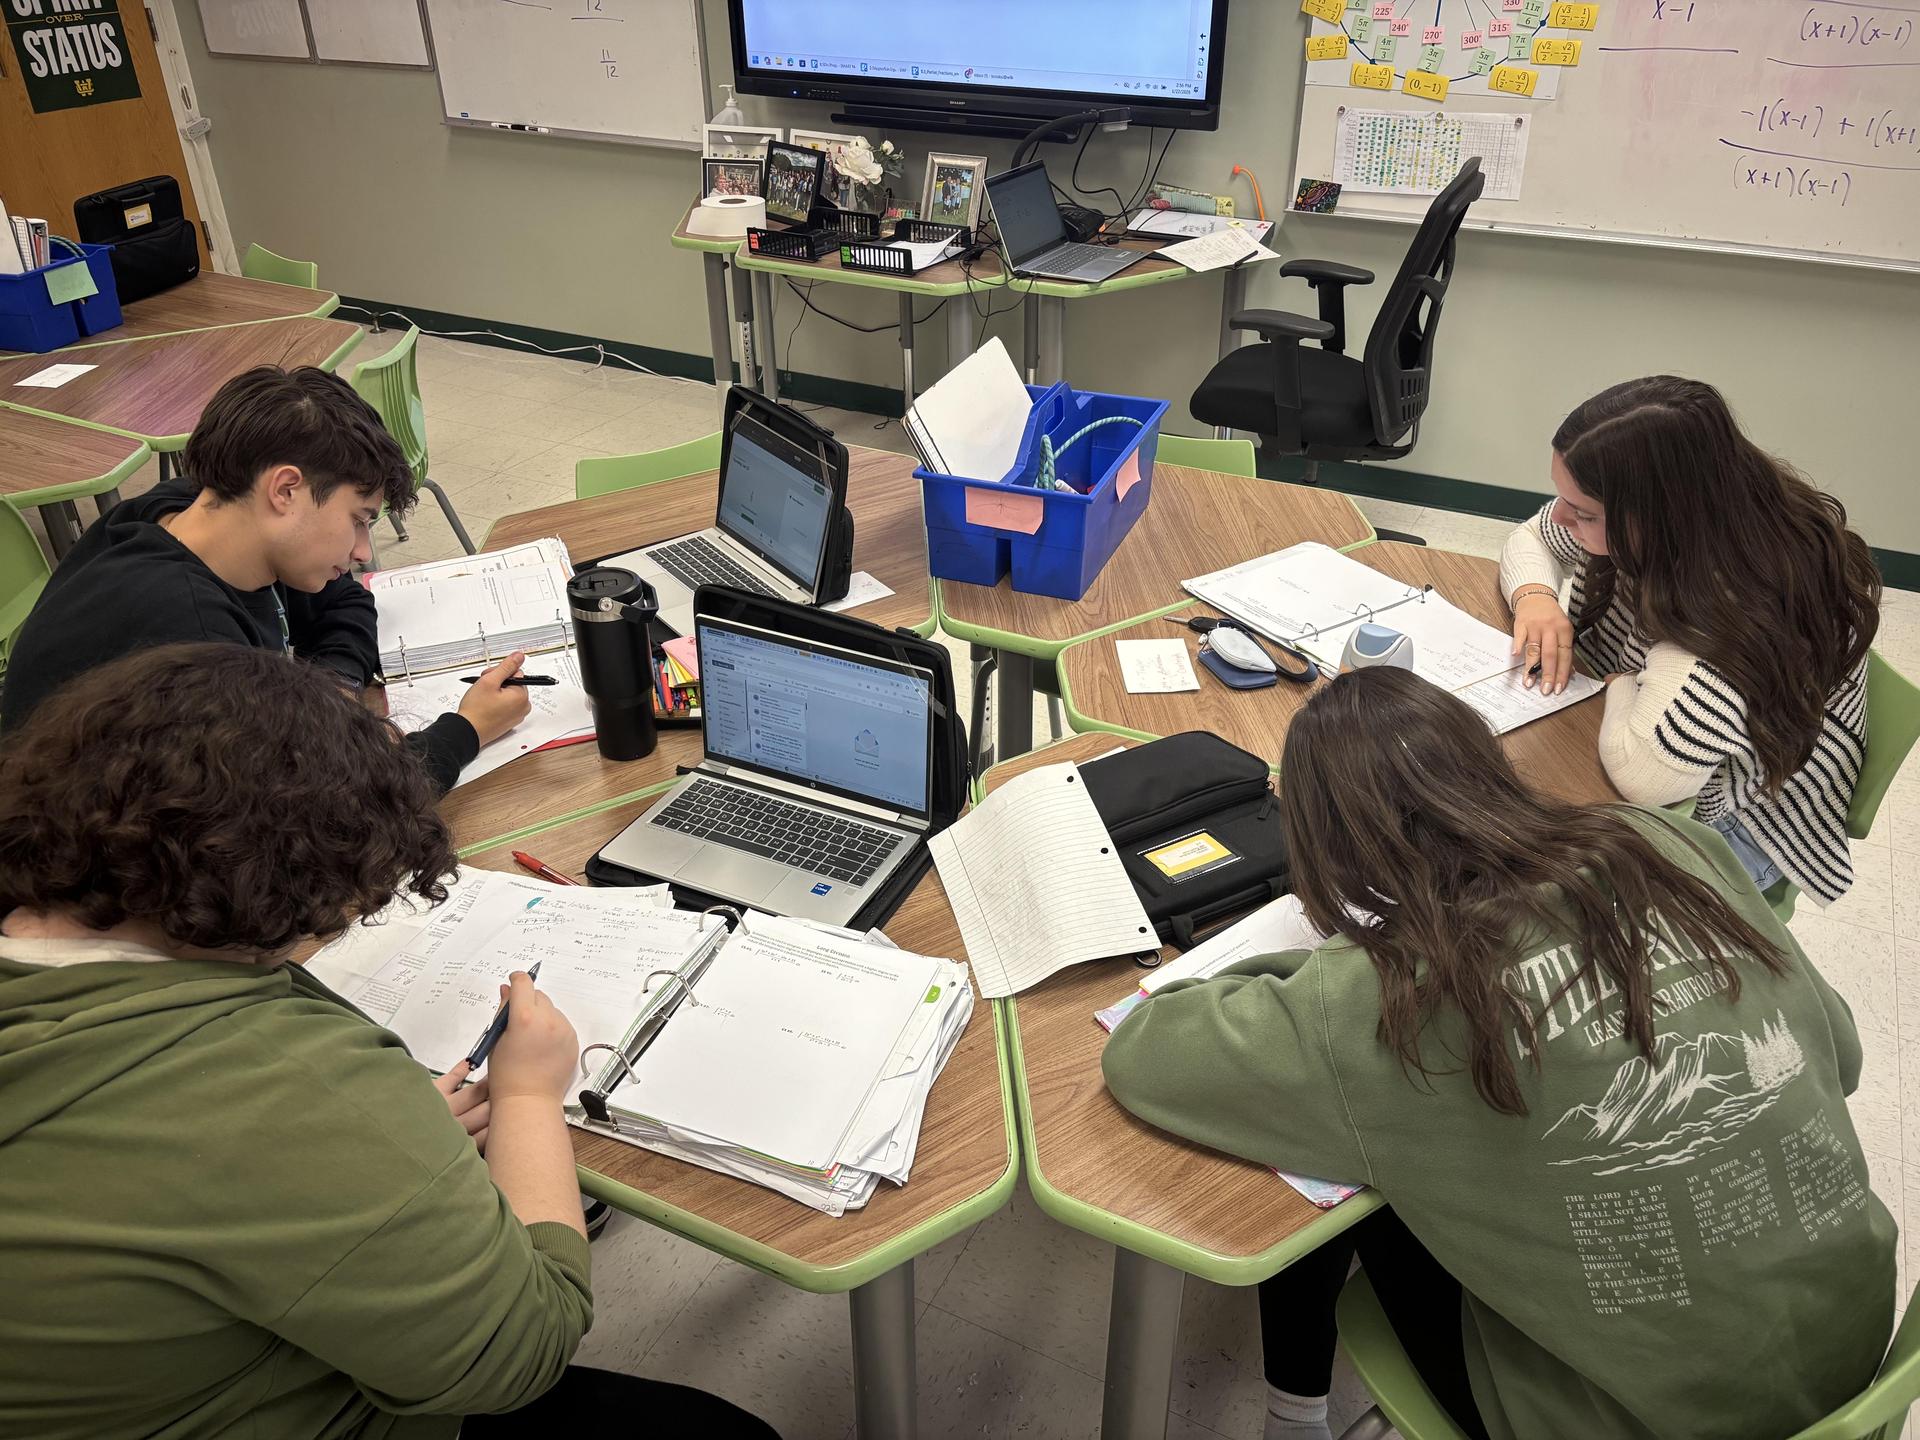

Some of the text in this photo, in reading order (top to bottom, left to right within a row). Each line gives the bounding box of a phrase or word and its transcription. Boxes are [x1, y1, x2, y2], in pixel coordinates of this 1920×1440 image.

[45, 13, 84, 24] OVER
[22, 21, 122, 78] STATUS
[606, 65, 620, 78] 12
[1686, 1148, 1762, 1184] MY FATHER MY
[1564, 1184, 1663, 1202] THE LORD IS MY
[1690, 1166, 1768, 1202] YOUR GOODNESS
[1694, 1174, 1768, 1212] AND MERCY
[1792, 1182, 1812, 1198] HERE
[1579, 1210, 1610, 1219] SHALL
[1615, 1208, 1636, 1216] NOT
[1640, 1202, 1667, 1213] WANT
[1694, 1184, 1772, 1220] WILL FOLLOW ME
[1698, 1192, 1774, 1229] ALL OF MY DAYS
[1800, 1210, 1818, 1224] BEEN
[1842, 1180, 1860, 1195] TRUE
[1804, 1224, 1814, 1232] IN
[1816, 1208, 1838, 1226] EVERY
[1840, 1189, 1864, 1209] SEASON
[1570, 1211, 1669, 1228] HE LEADS ME BY
[1711, 1221, 1736, 1235] KNOW
[1742, 1214, 1752, 1224] BY
[1756, 1202, 1776, 1216] YOUR
[1572, 1220, 1672, 1236] STILL WATERS
[1598, 1236, 1614, 1245] MY
[1618, 1232, 1649, 1242] FEARS
[1654, 1228, 1674, 1238] ARE
[1702, 1234, 1726, 1246] STILL
[1732, 1220, 1763, 1236] WATERS
[1808, 1232, 1818, 1242] OF
[1831, 1216, 1842, 1227] MY
[1579, 1253, 1623, 1262] THOUGH
[1650, 1246, 1679, 1256] WALK
[1583, 1254, 1680, 1270] THROUGH THE
[1603, 1280, 1624, 1288] THE
[1626, 1274, 1668, 1286] SHADOW
[1672, 1272, 1686, 1280] OF
[1592, 1298, 1608, 1306] OH
[1618, 1295, 1646, 1305] KNOW
[1648, 1292, 1668, 1302] YOU
[1670, 1288, 1690, 1298] ARE
[1594, 1298, 1692, 1314] WITH ME
